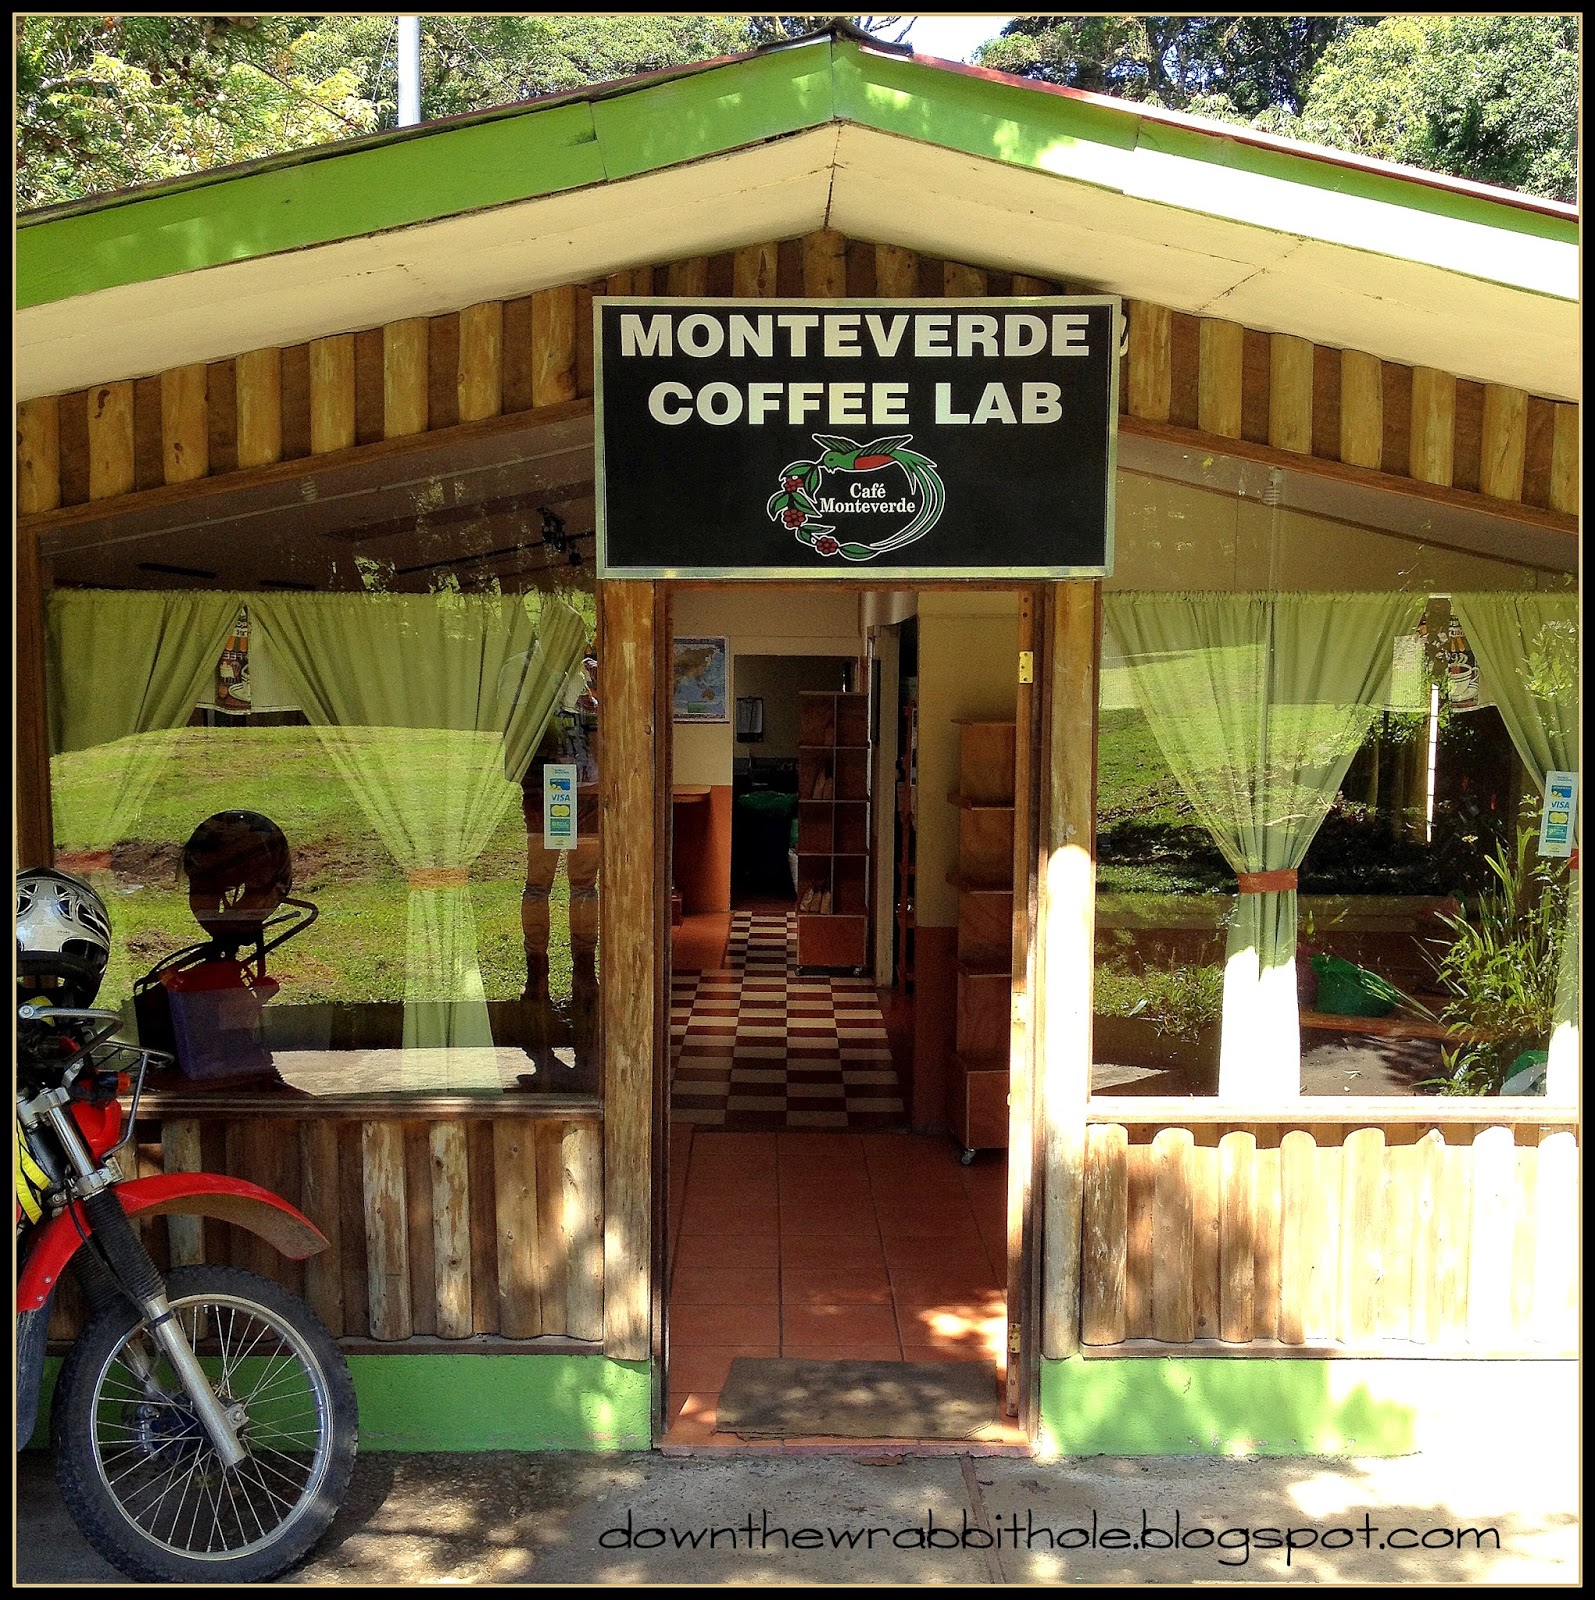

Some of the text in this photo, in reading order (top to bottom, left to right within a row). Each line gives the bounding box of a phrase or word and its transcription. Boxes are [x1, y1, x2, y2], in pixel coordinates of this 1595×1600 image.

[620, 313, 1090, 358] MONTEVERDE
[648, 381, 1064, 426] COFFEE LAB
[849, 482, 887, 500] Café
[819, 497, 916, 515] Monteverde
[551, 793, 571, 802] VISA
[1551, 801, 1570, 809] VISA
